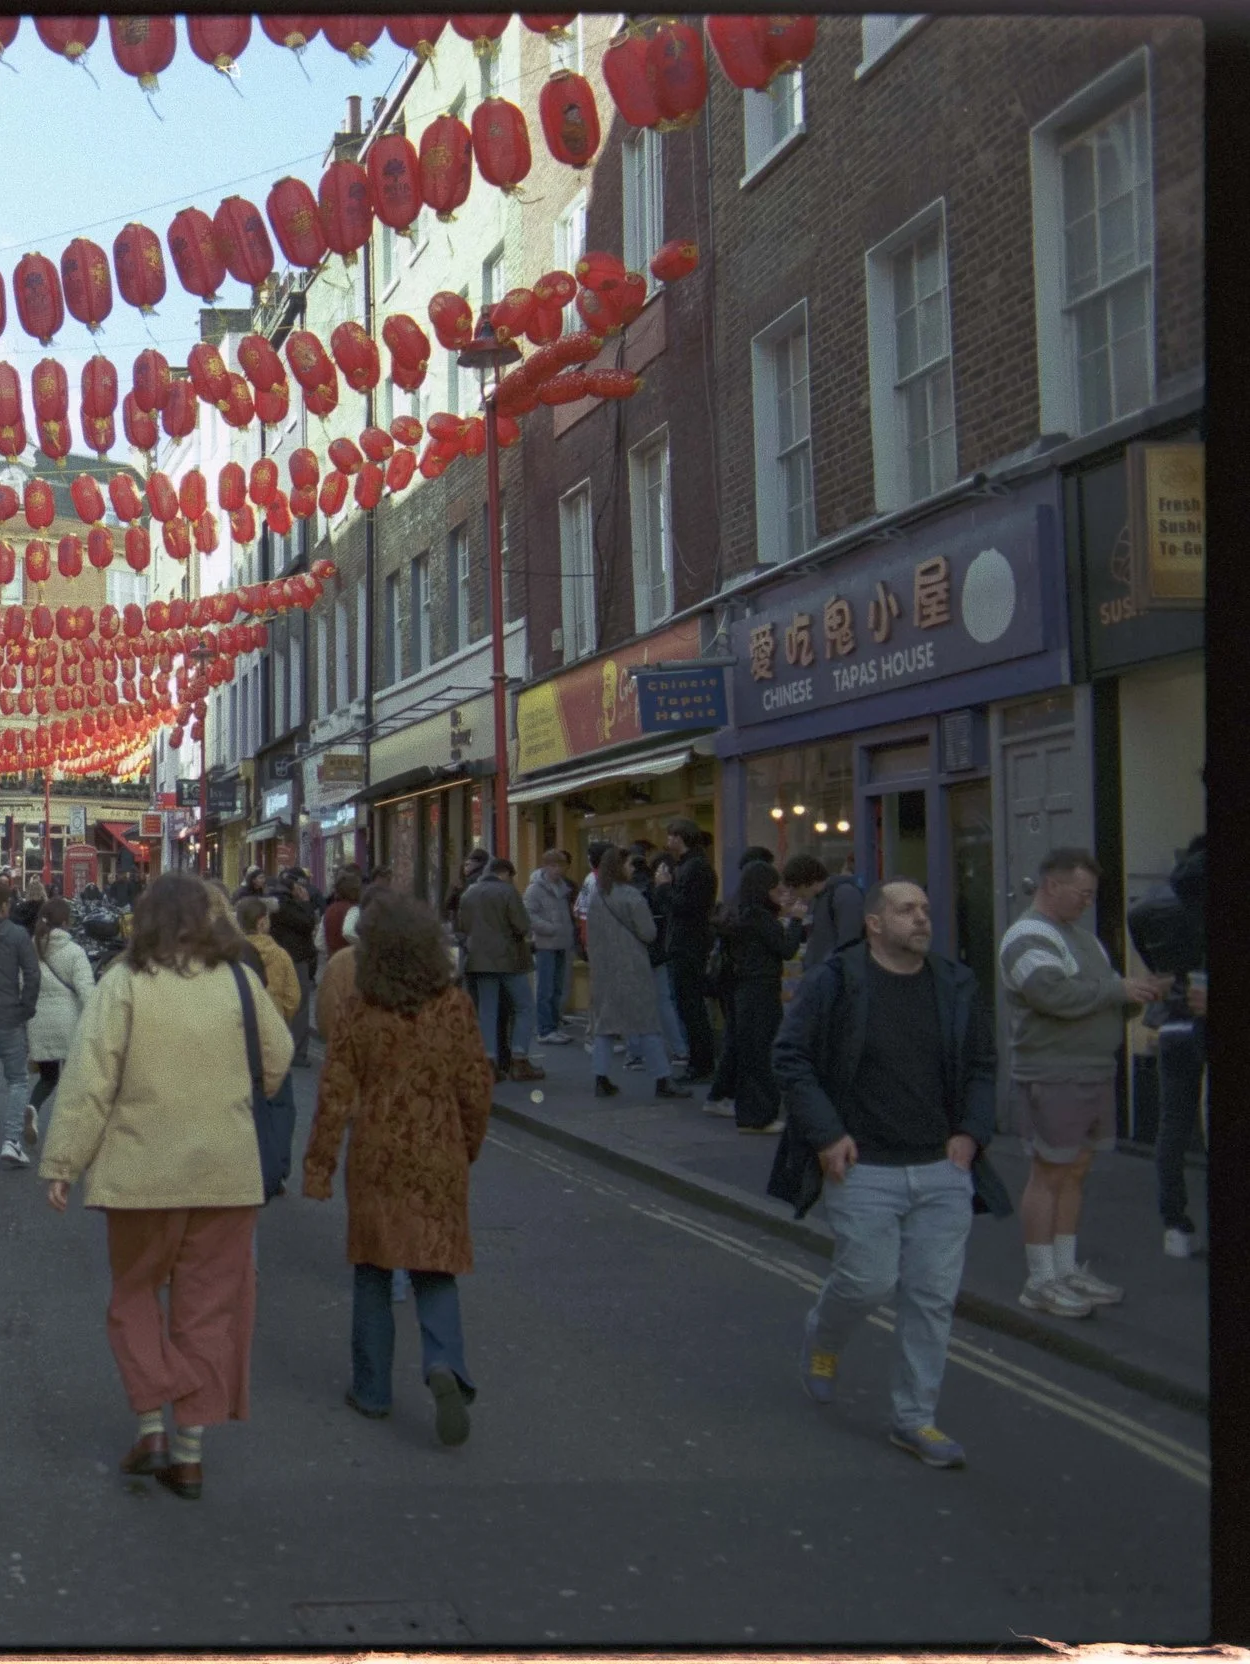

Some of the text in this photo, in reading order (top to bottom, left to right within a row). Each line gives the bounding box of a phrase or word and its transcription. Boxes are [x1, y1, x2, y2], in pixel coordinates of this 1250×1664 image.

[1158, 497, 1201, 512] Fresh
[1158, 518, 1202, 533] Sushi
[750, 555, 950, 681] 愛吃鬼小屋
[763, 641, 935, 711] CHINESE TAPAS HOUSE
[647, 678, 717, 692] Chinese
[656, 693, 713, 707] Tapas
[655, 708, 717, 721] House
